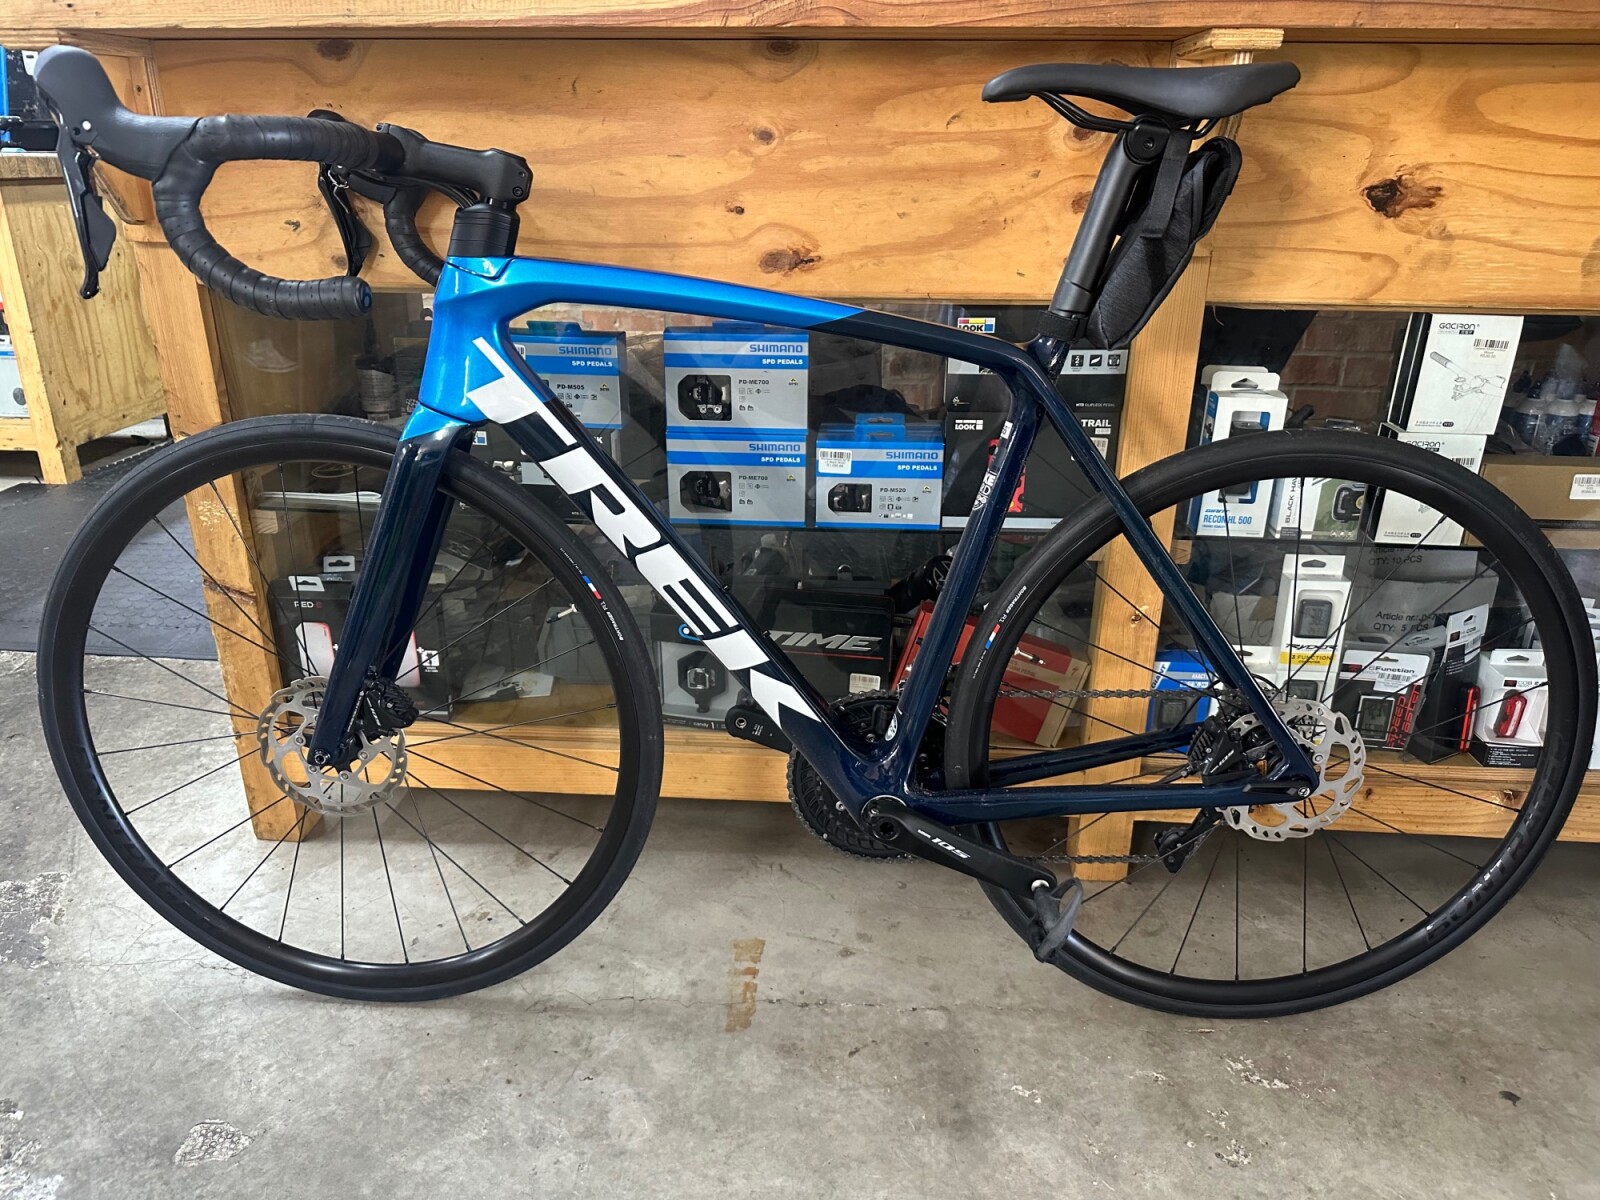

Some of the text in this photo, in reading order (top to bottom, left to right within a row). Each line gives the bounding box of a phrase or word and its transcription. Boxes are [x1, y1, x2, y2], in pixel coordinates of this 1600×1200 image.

[558, 346, 612, 355] SHIMANO
[750, 344, 803, 353] SHIMANO
[1081, 419, 1112, 427] TRAIL
[749, 443, 801, 452] SHIMANO
[886, 451, 939, 460] SHIMANO
[1284, 495, 1295, 524] BLACK
[1203, 514, 1252, 525] RECON HL 500
[466, 336, 822, 731] TREK
[1376, 611, 1404, 621] Article
[1373, 622, 1395, 632] QTY:
[768, 630, 882, 651] TIME
[1151, 663, 1167, 688] GIANT
[931, 837, 971, 859] 105
